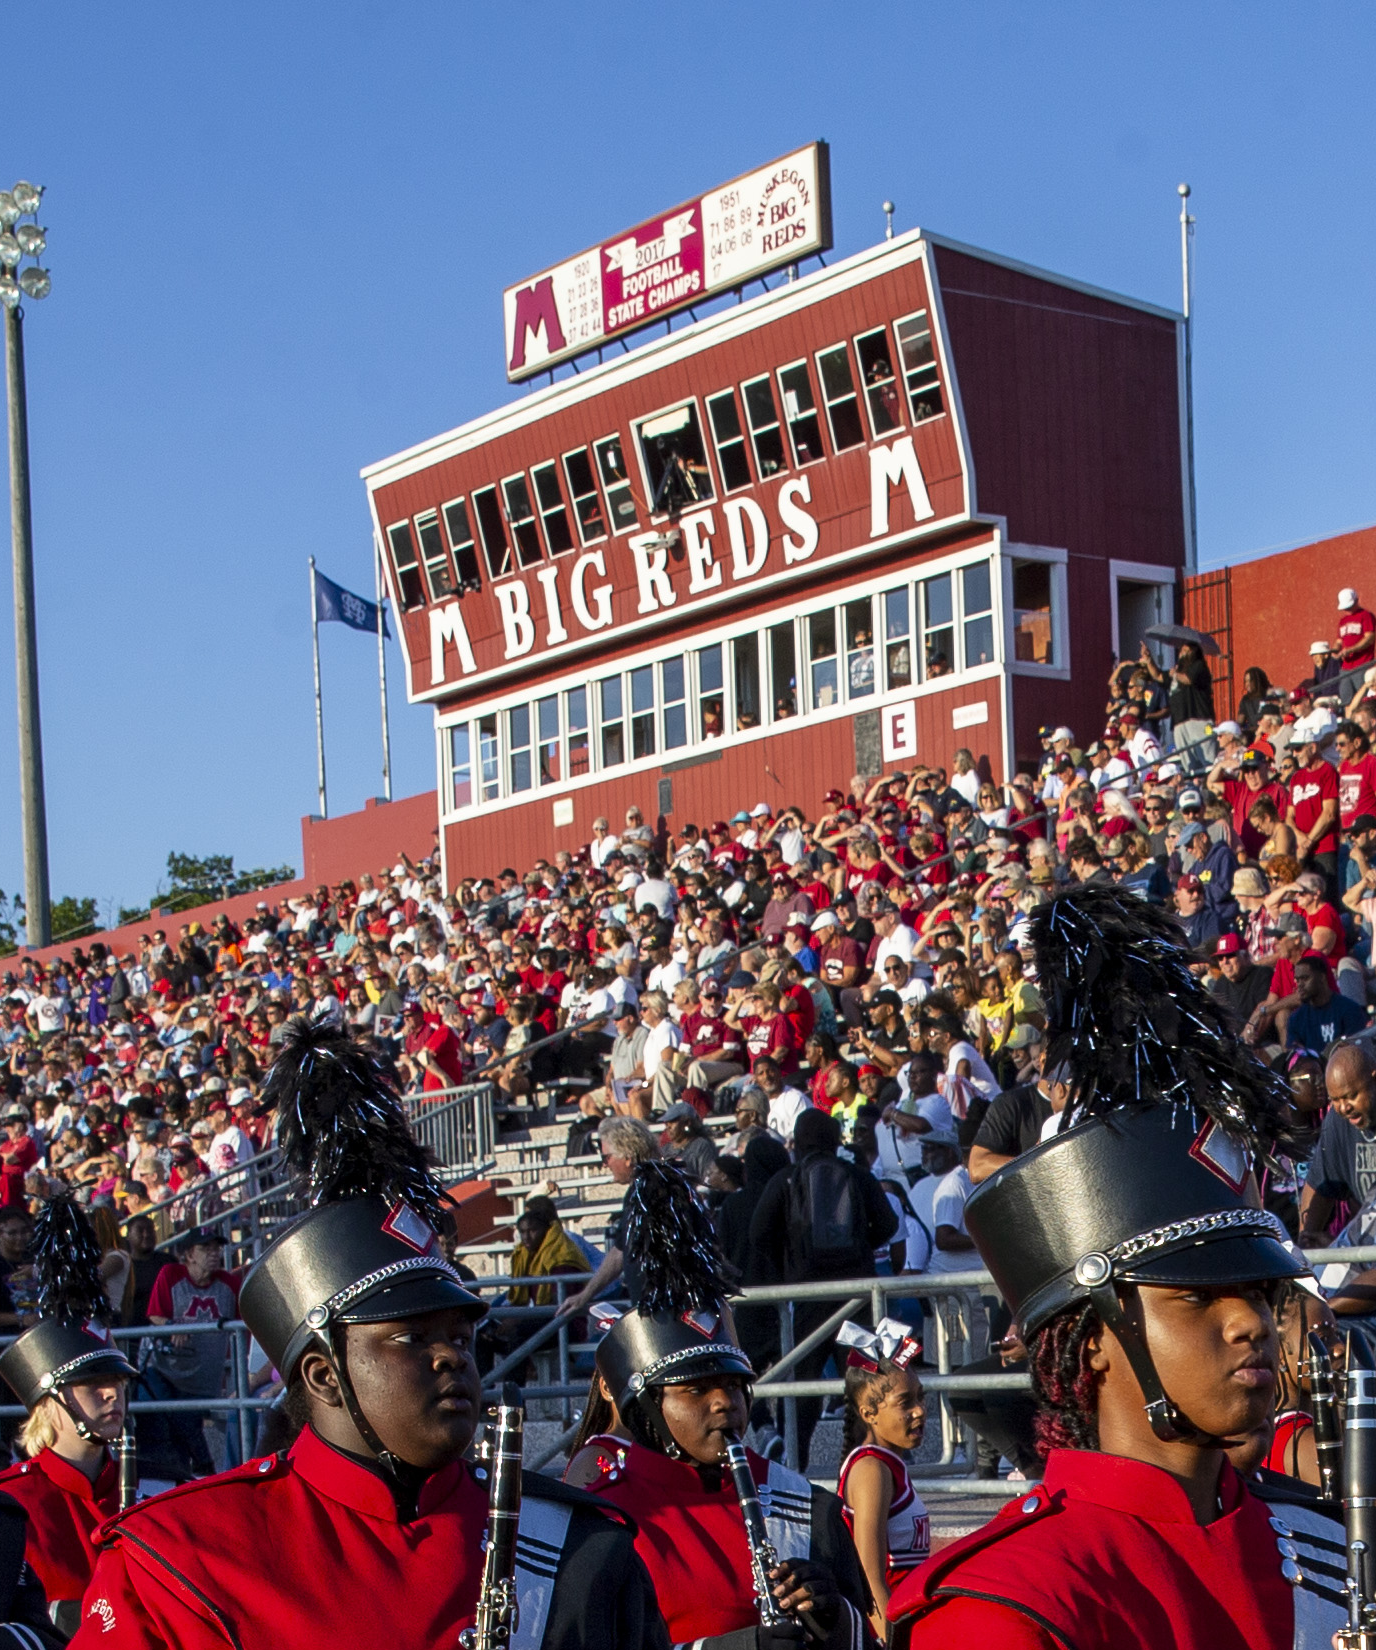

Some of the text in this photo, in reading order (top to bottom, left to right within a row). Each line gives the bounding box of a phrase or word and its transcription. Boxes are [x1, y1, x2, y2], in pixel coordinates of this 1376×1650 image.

[720, 190, 740, 212] 1951
[757, 168, 811, 228] MUSKEGON
[770, 196, 796, 225] BIG
[710, 222, 720, 238] 71
[762, 218, 806, 254] REDS
[635, 239, 666, 269] 2017
[711, 242, 722, 260] 04
[622, 255, 684, 300] FOOTBALL
[608, 269, 701, 328] STATE CHAMPS
[509, 275, 567, 371] M
[428, 435, 936, 686] M BIG REDS M
[891, 712, 907, 749] E
[182, 1294, 223, 1321] M
